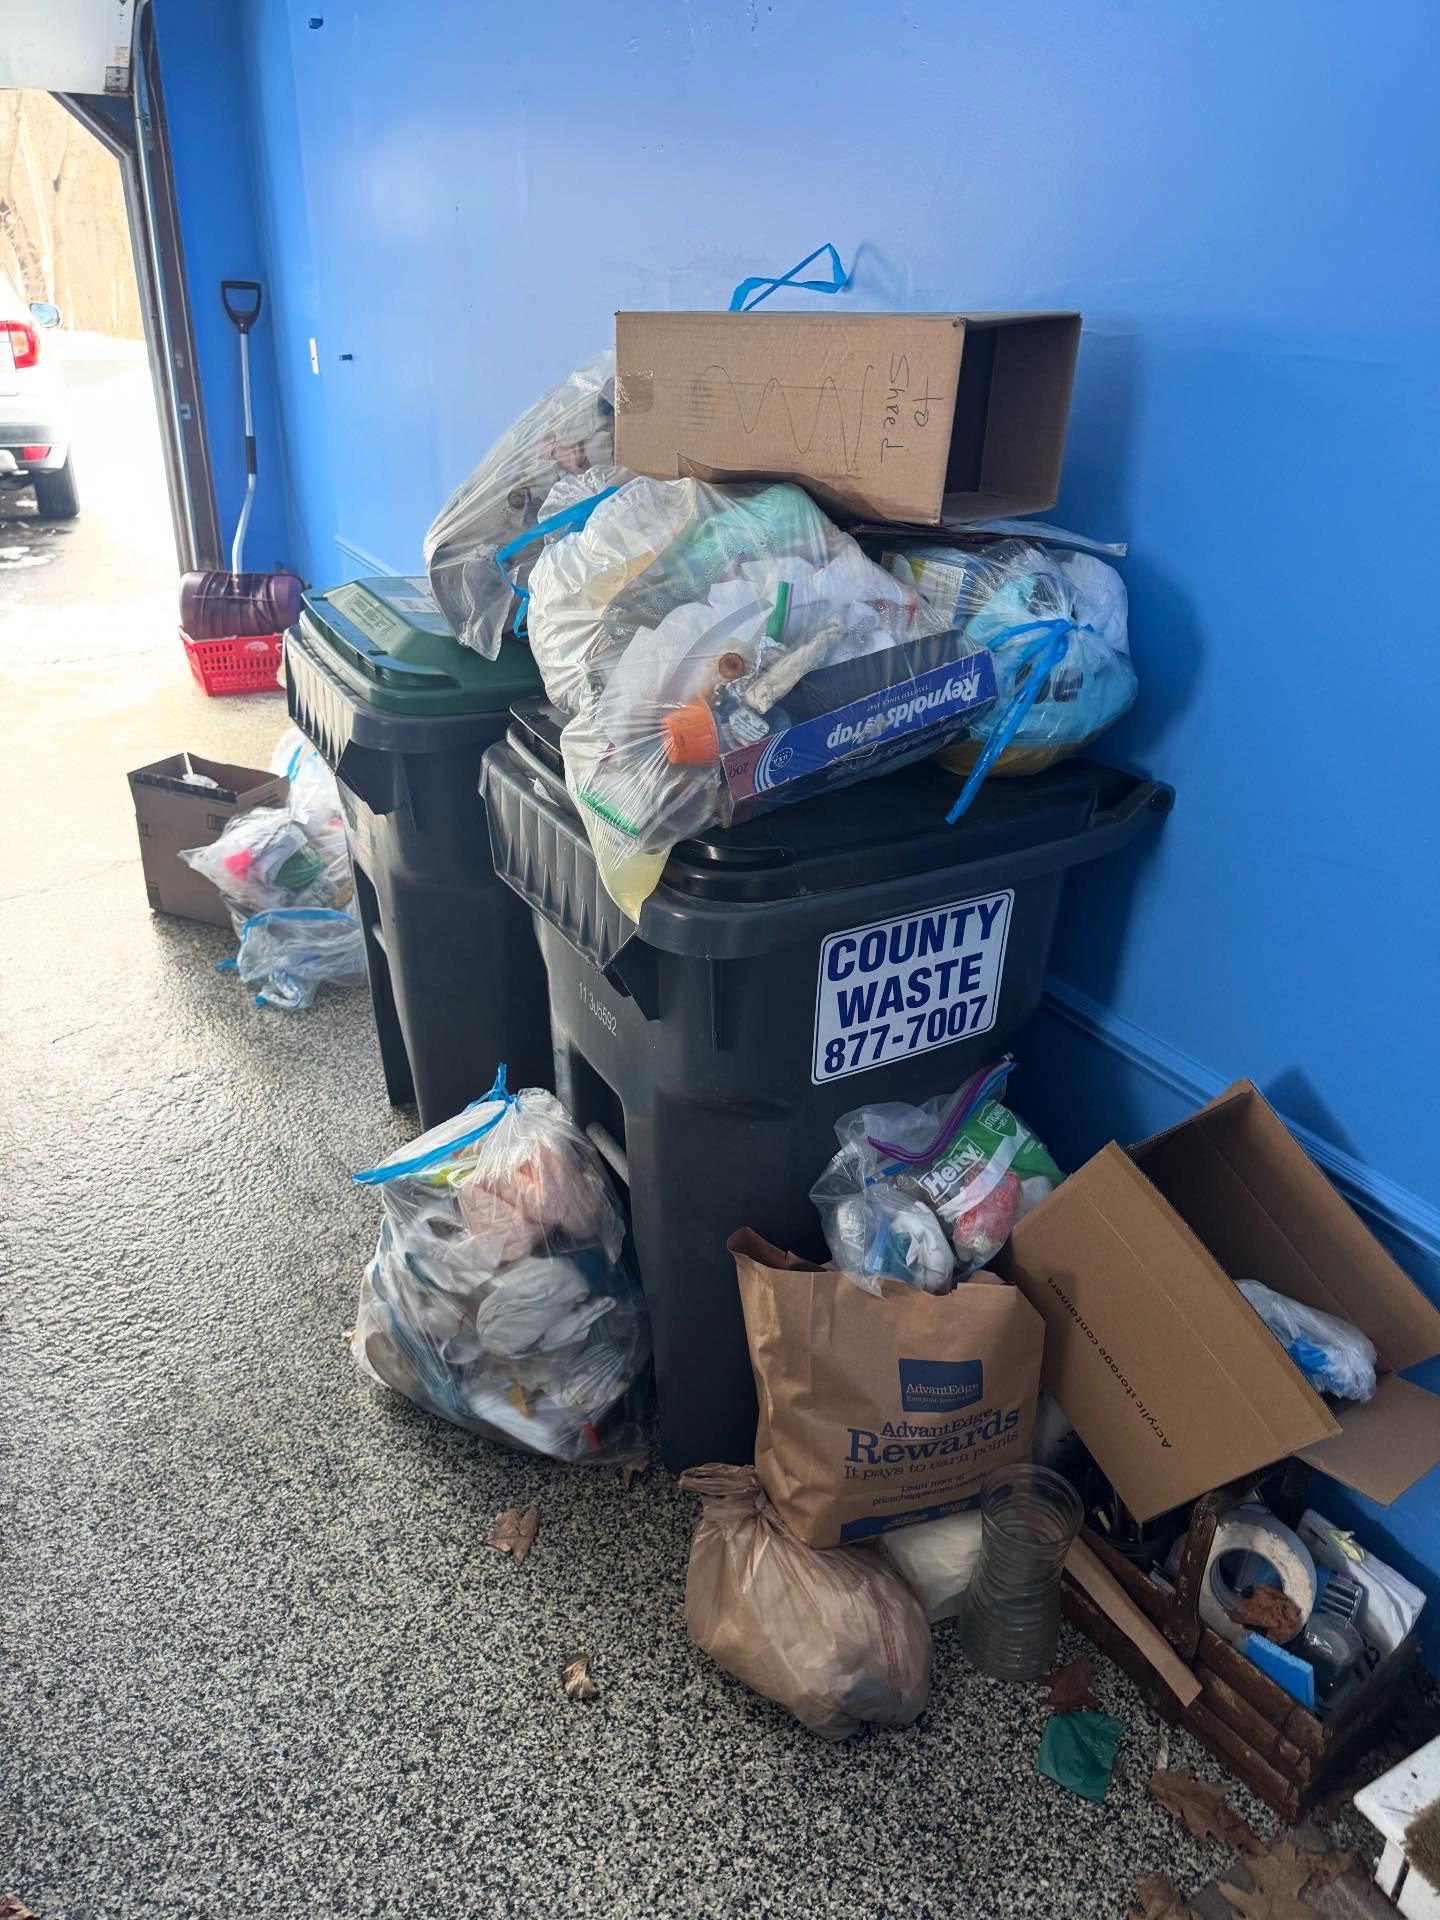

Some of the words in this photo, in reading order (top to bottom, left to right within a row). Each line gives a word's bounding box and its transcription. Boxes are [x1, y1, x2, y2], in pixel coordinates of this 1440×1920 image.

[880, 353, 910, 462] Shred
[912, 376, 944, 427] to
[886, 672, 981, 728] Reynolds
[826, 712, 888, 750] rap
[827, 899, 1005, 982] COUNTY
[837, 952, 984, 1029] WASTE
[824, 994, 988, 1074] 877-7007
[924, 1145, 979, 1196] Hefty
[1048, 1277, 1099, 1345] containers
[906, 1382, 979, 1396] AdvantEdge
[1099, 1347, 1137, 1399] storage
[845, 1408, 1020, 1465] Rewards
[880, 1408, 994, 1438] AdvantEdge
[1136, 1400, 1172, 1448] Acrylic
[844, 1465, 858, 1480] It
[863, 1466, 904, 1481] pays
[909, 1462, 925, 1473] to
[930, 1454, 969, 1470] earn
[973, 1432, 1018, 1460] points
[901, 1482, 929, 1493] Learn
